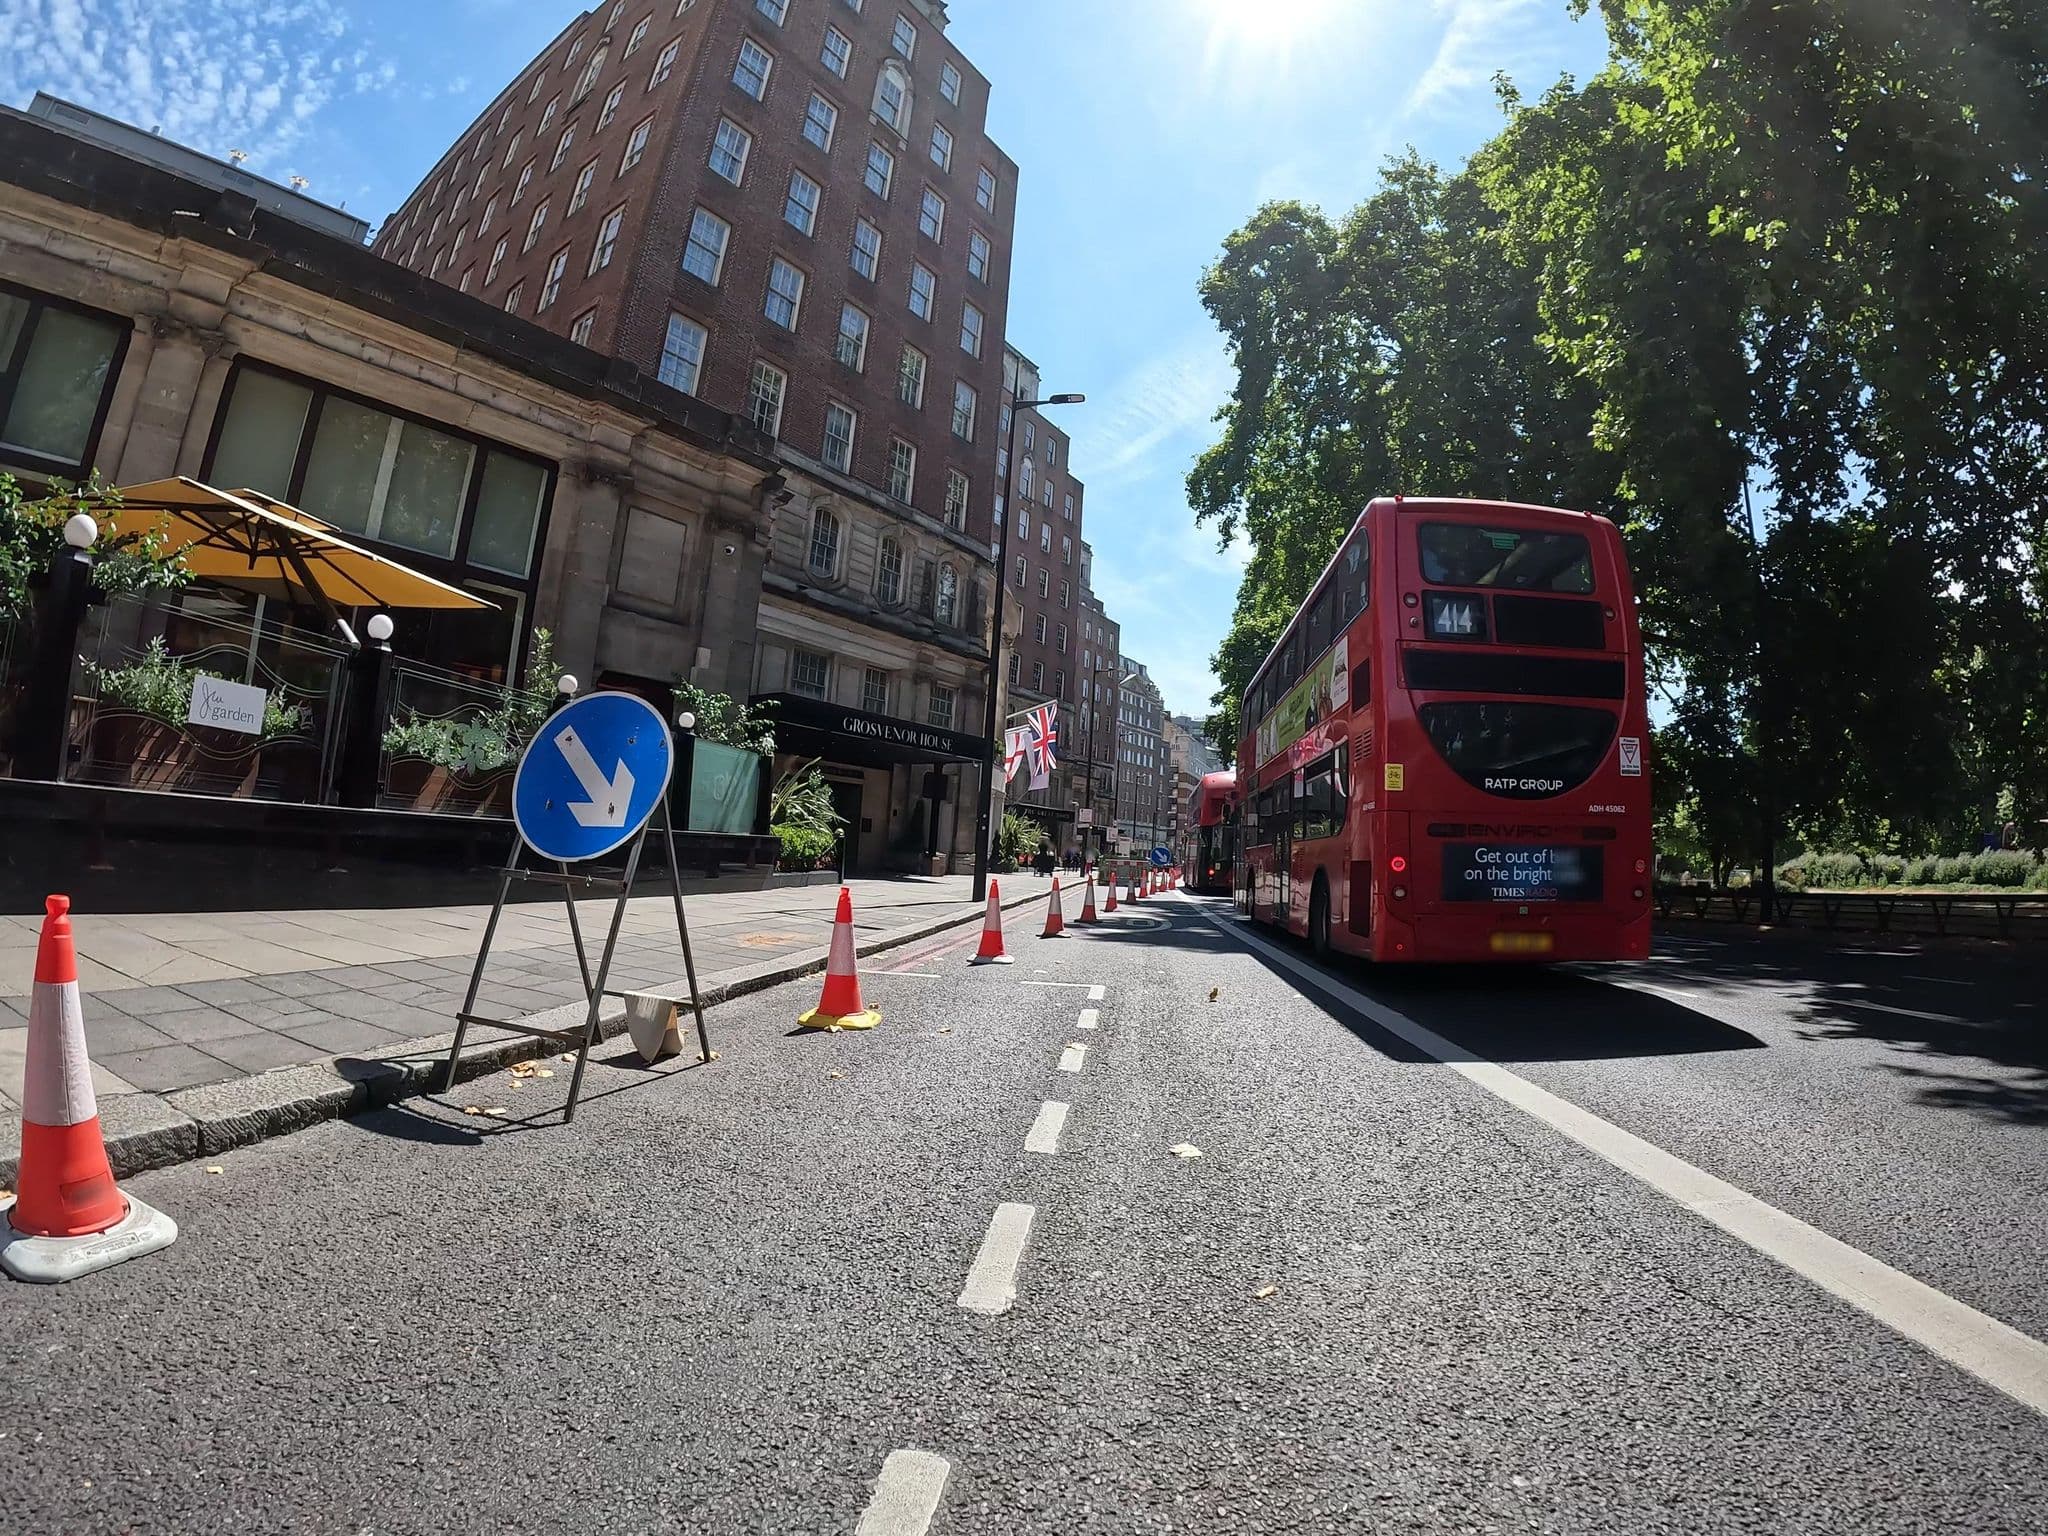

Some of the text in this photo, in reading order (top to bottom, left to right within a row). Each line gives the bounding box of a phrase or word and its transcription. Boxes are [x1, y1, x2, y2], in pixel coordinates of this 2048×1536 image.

[1438, 603, 1472, 633] 414
[211, 707, 255, 724] garden
[843, 716, 953, 751] GROSVENOR HOUSE
[1485, 778, 1564, 792] RATP GROUP
[1588, 804, 1605, 813] ADH
[1475, 847, 1502, 864] Get
[1505, 851, 1530, 864] out
[1532, 848, 1548, 864] of
[1464, 868, 1483, 881] on
[1486, 866, 1509, 881] the
[1513, 866, 1553, 885] bright
[1491, 887, 1525, 897] TIMES
